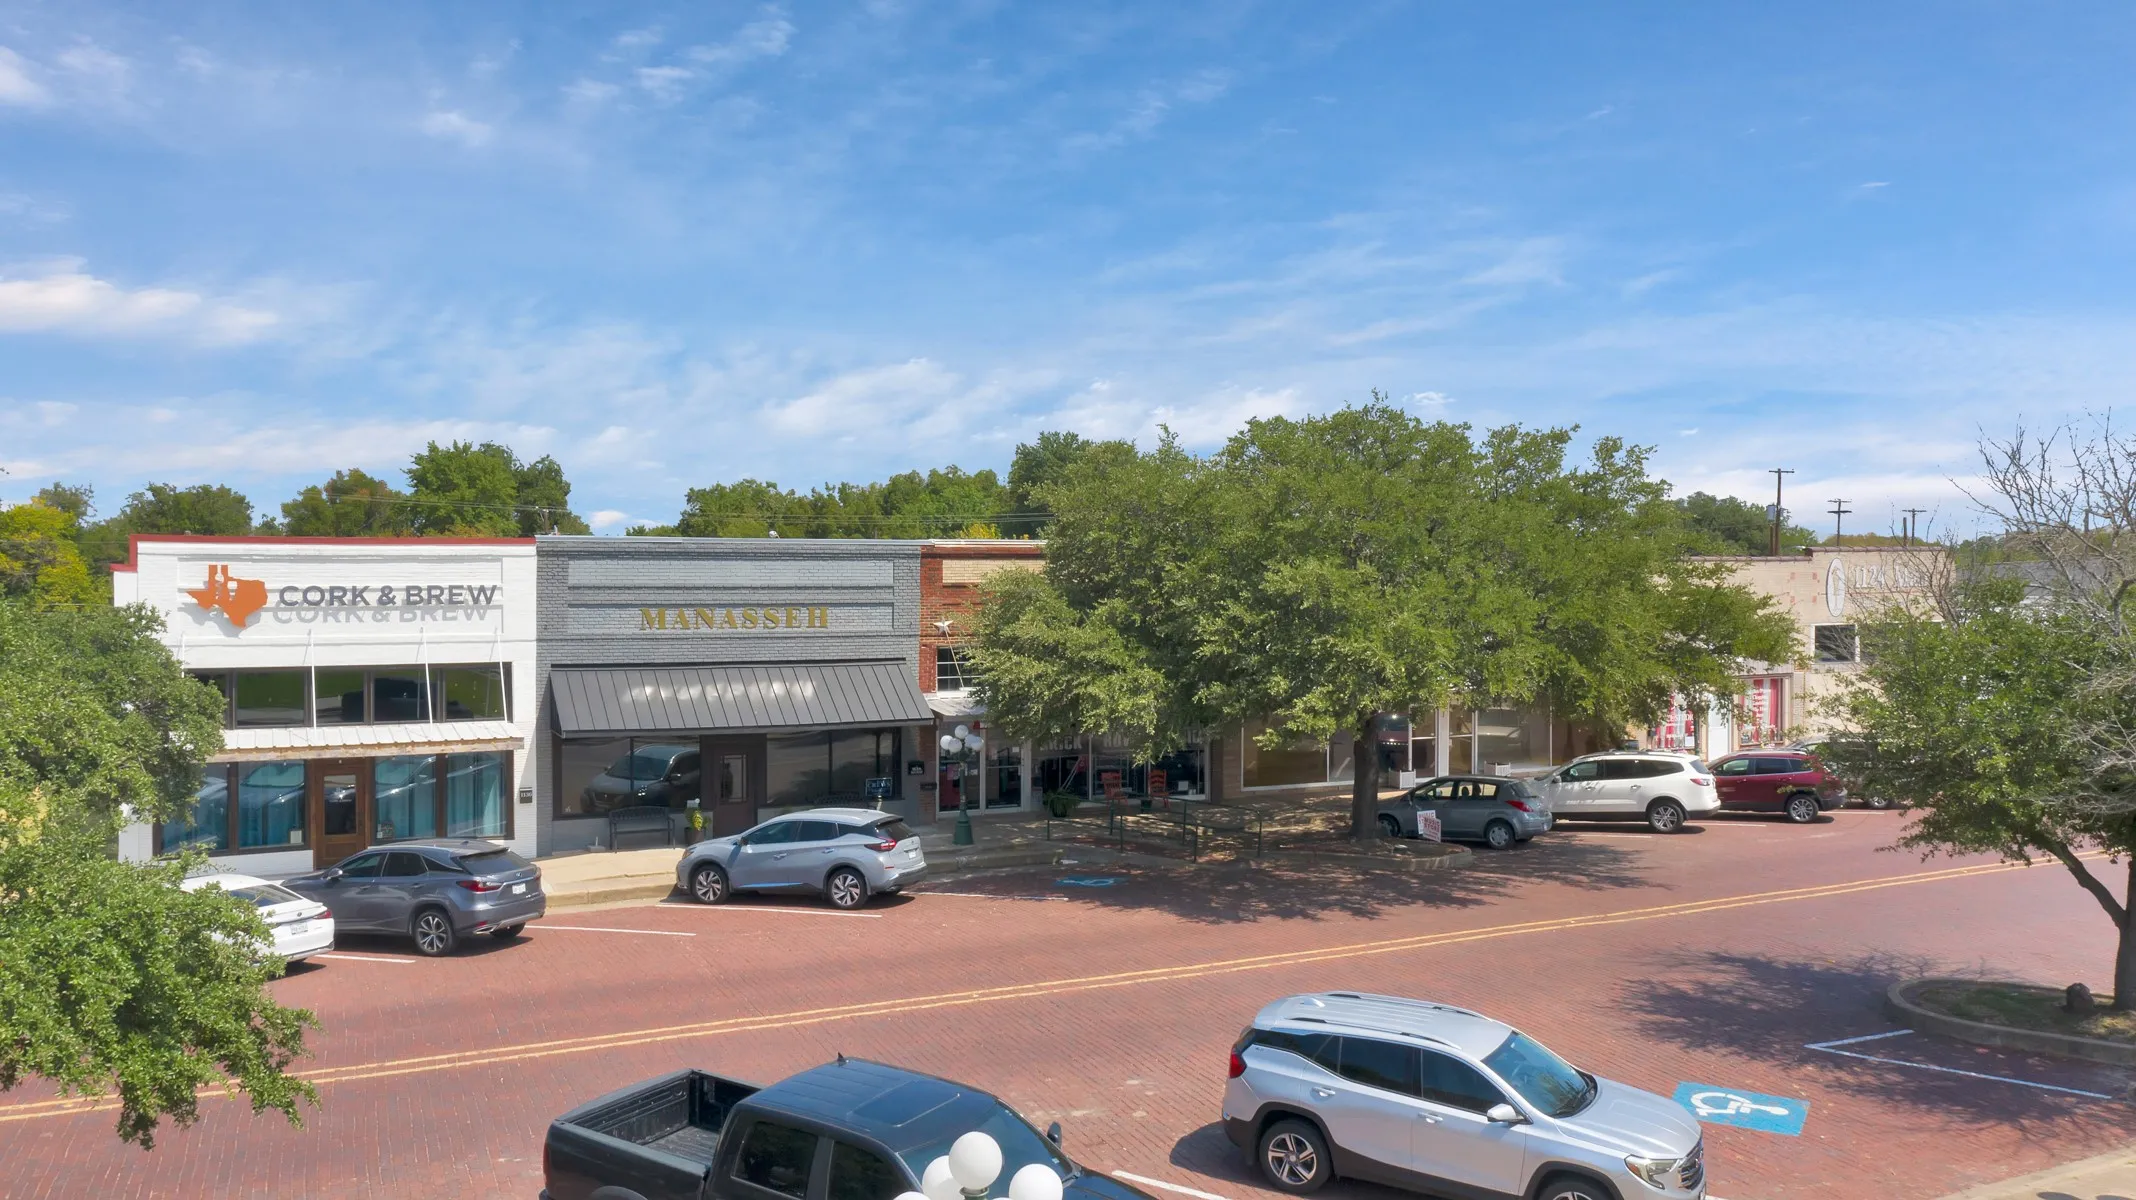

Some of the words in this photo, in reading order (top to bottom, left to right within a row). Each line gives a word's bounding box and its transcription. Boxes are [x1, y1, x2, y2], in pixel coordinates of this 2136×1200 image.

[1853, 564, 1886, 589] 1124
[279, 585, 370, 607] CORK
[377, 585, 397, 606] &
[405, 584, 498, 606] BREW
[640, 606, 829, 631] MANASSEH
